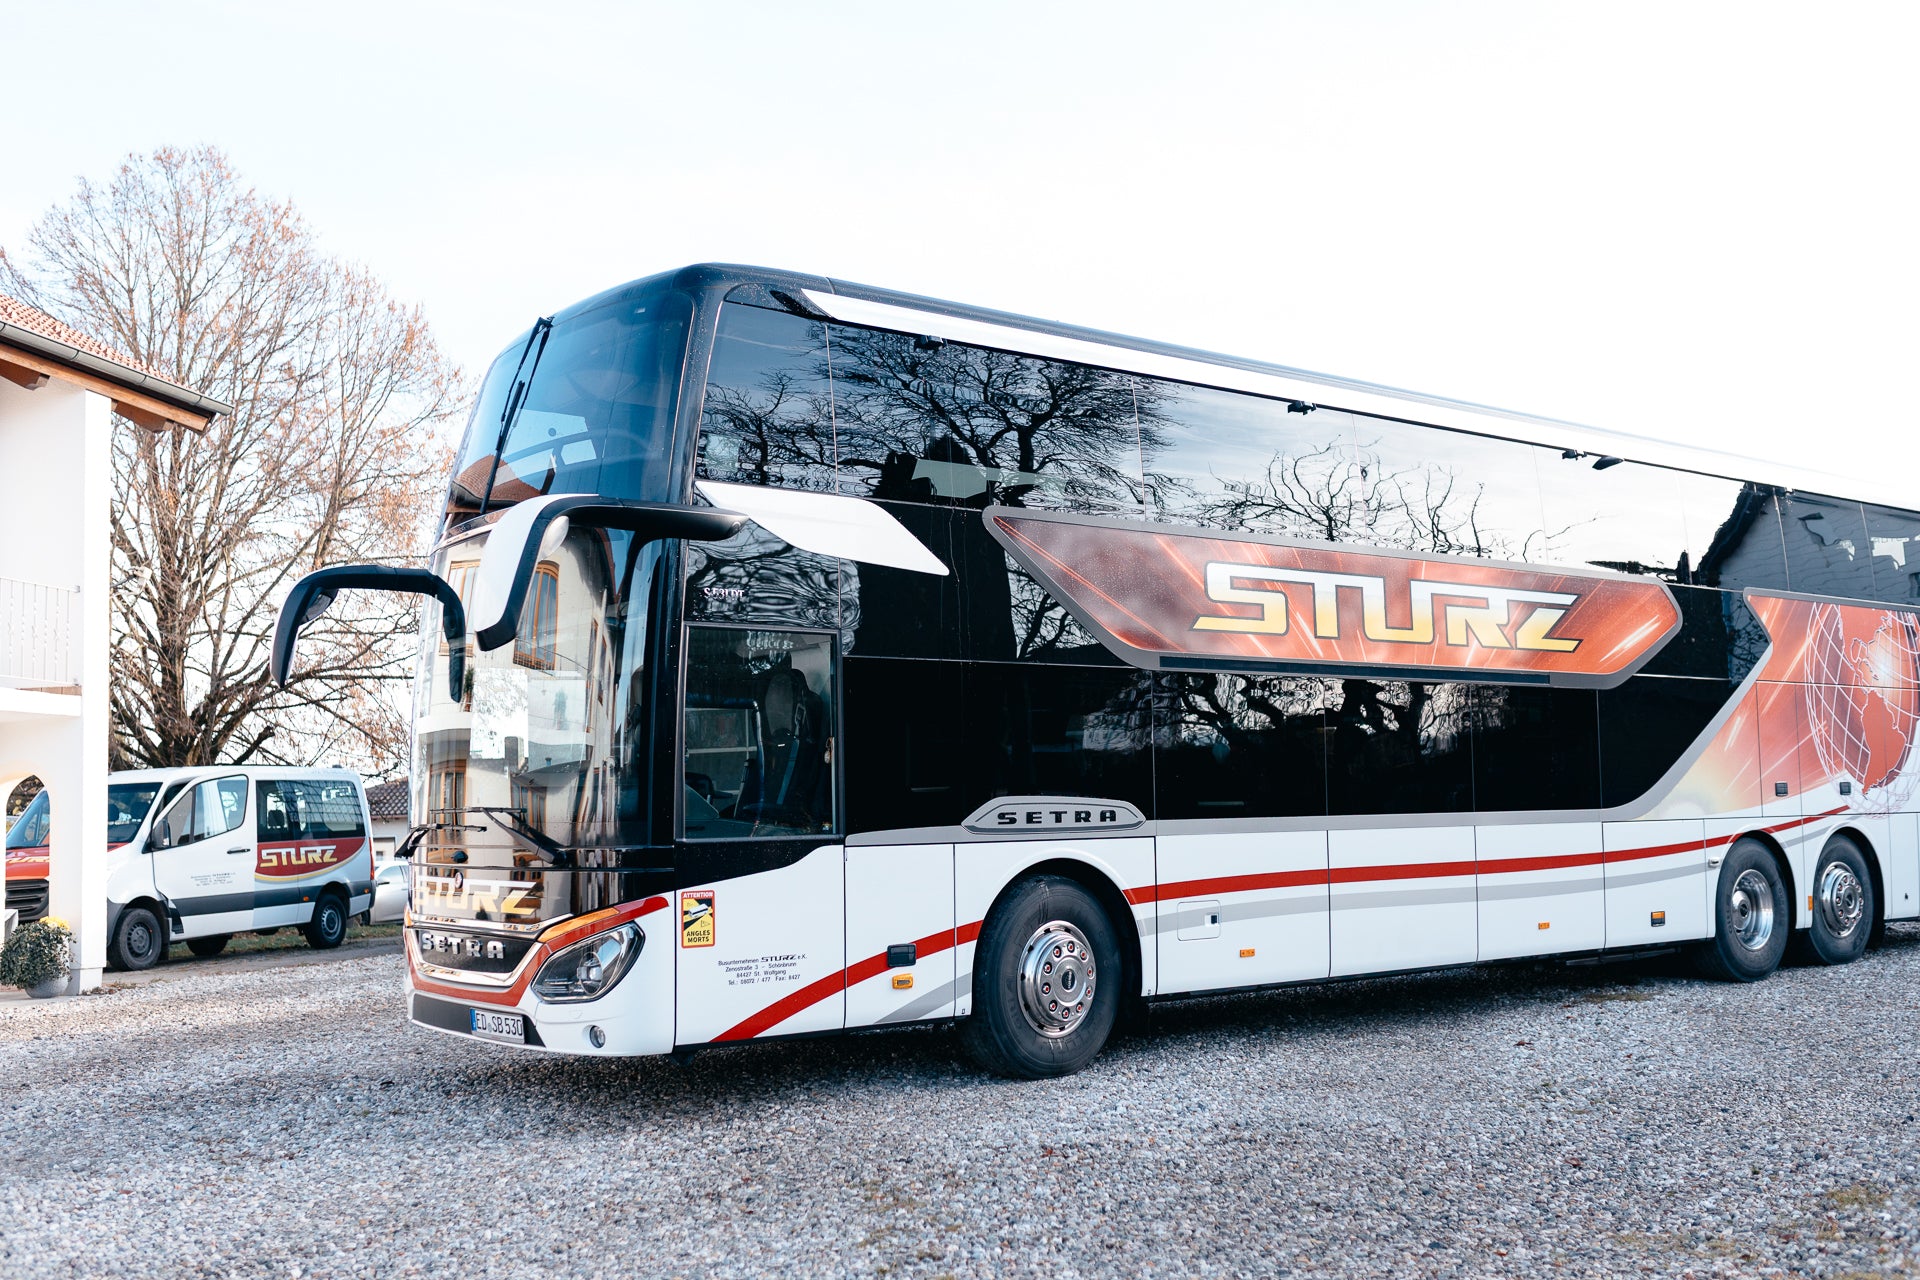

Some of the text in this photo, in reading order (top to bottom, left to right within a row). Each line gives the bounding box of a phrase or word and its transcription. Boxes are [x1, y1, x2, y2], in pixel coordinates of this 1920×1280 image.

[1190, 560, 1583, 653] STURZ
[997, 810, 1117, 825] SETRA
[260, 845, 338, 868] STURZ
[416, 876, 537, 916] STURZ
[683, 891, 714, 899] ATTENTION
[422, 932, 505, 959] SETRA
[718, 958, 760, 966] Busunternehmen
[760, 954, 797, 963] STURZ
[476, 1012, 523, 1036] ED SB 530
